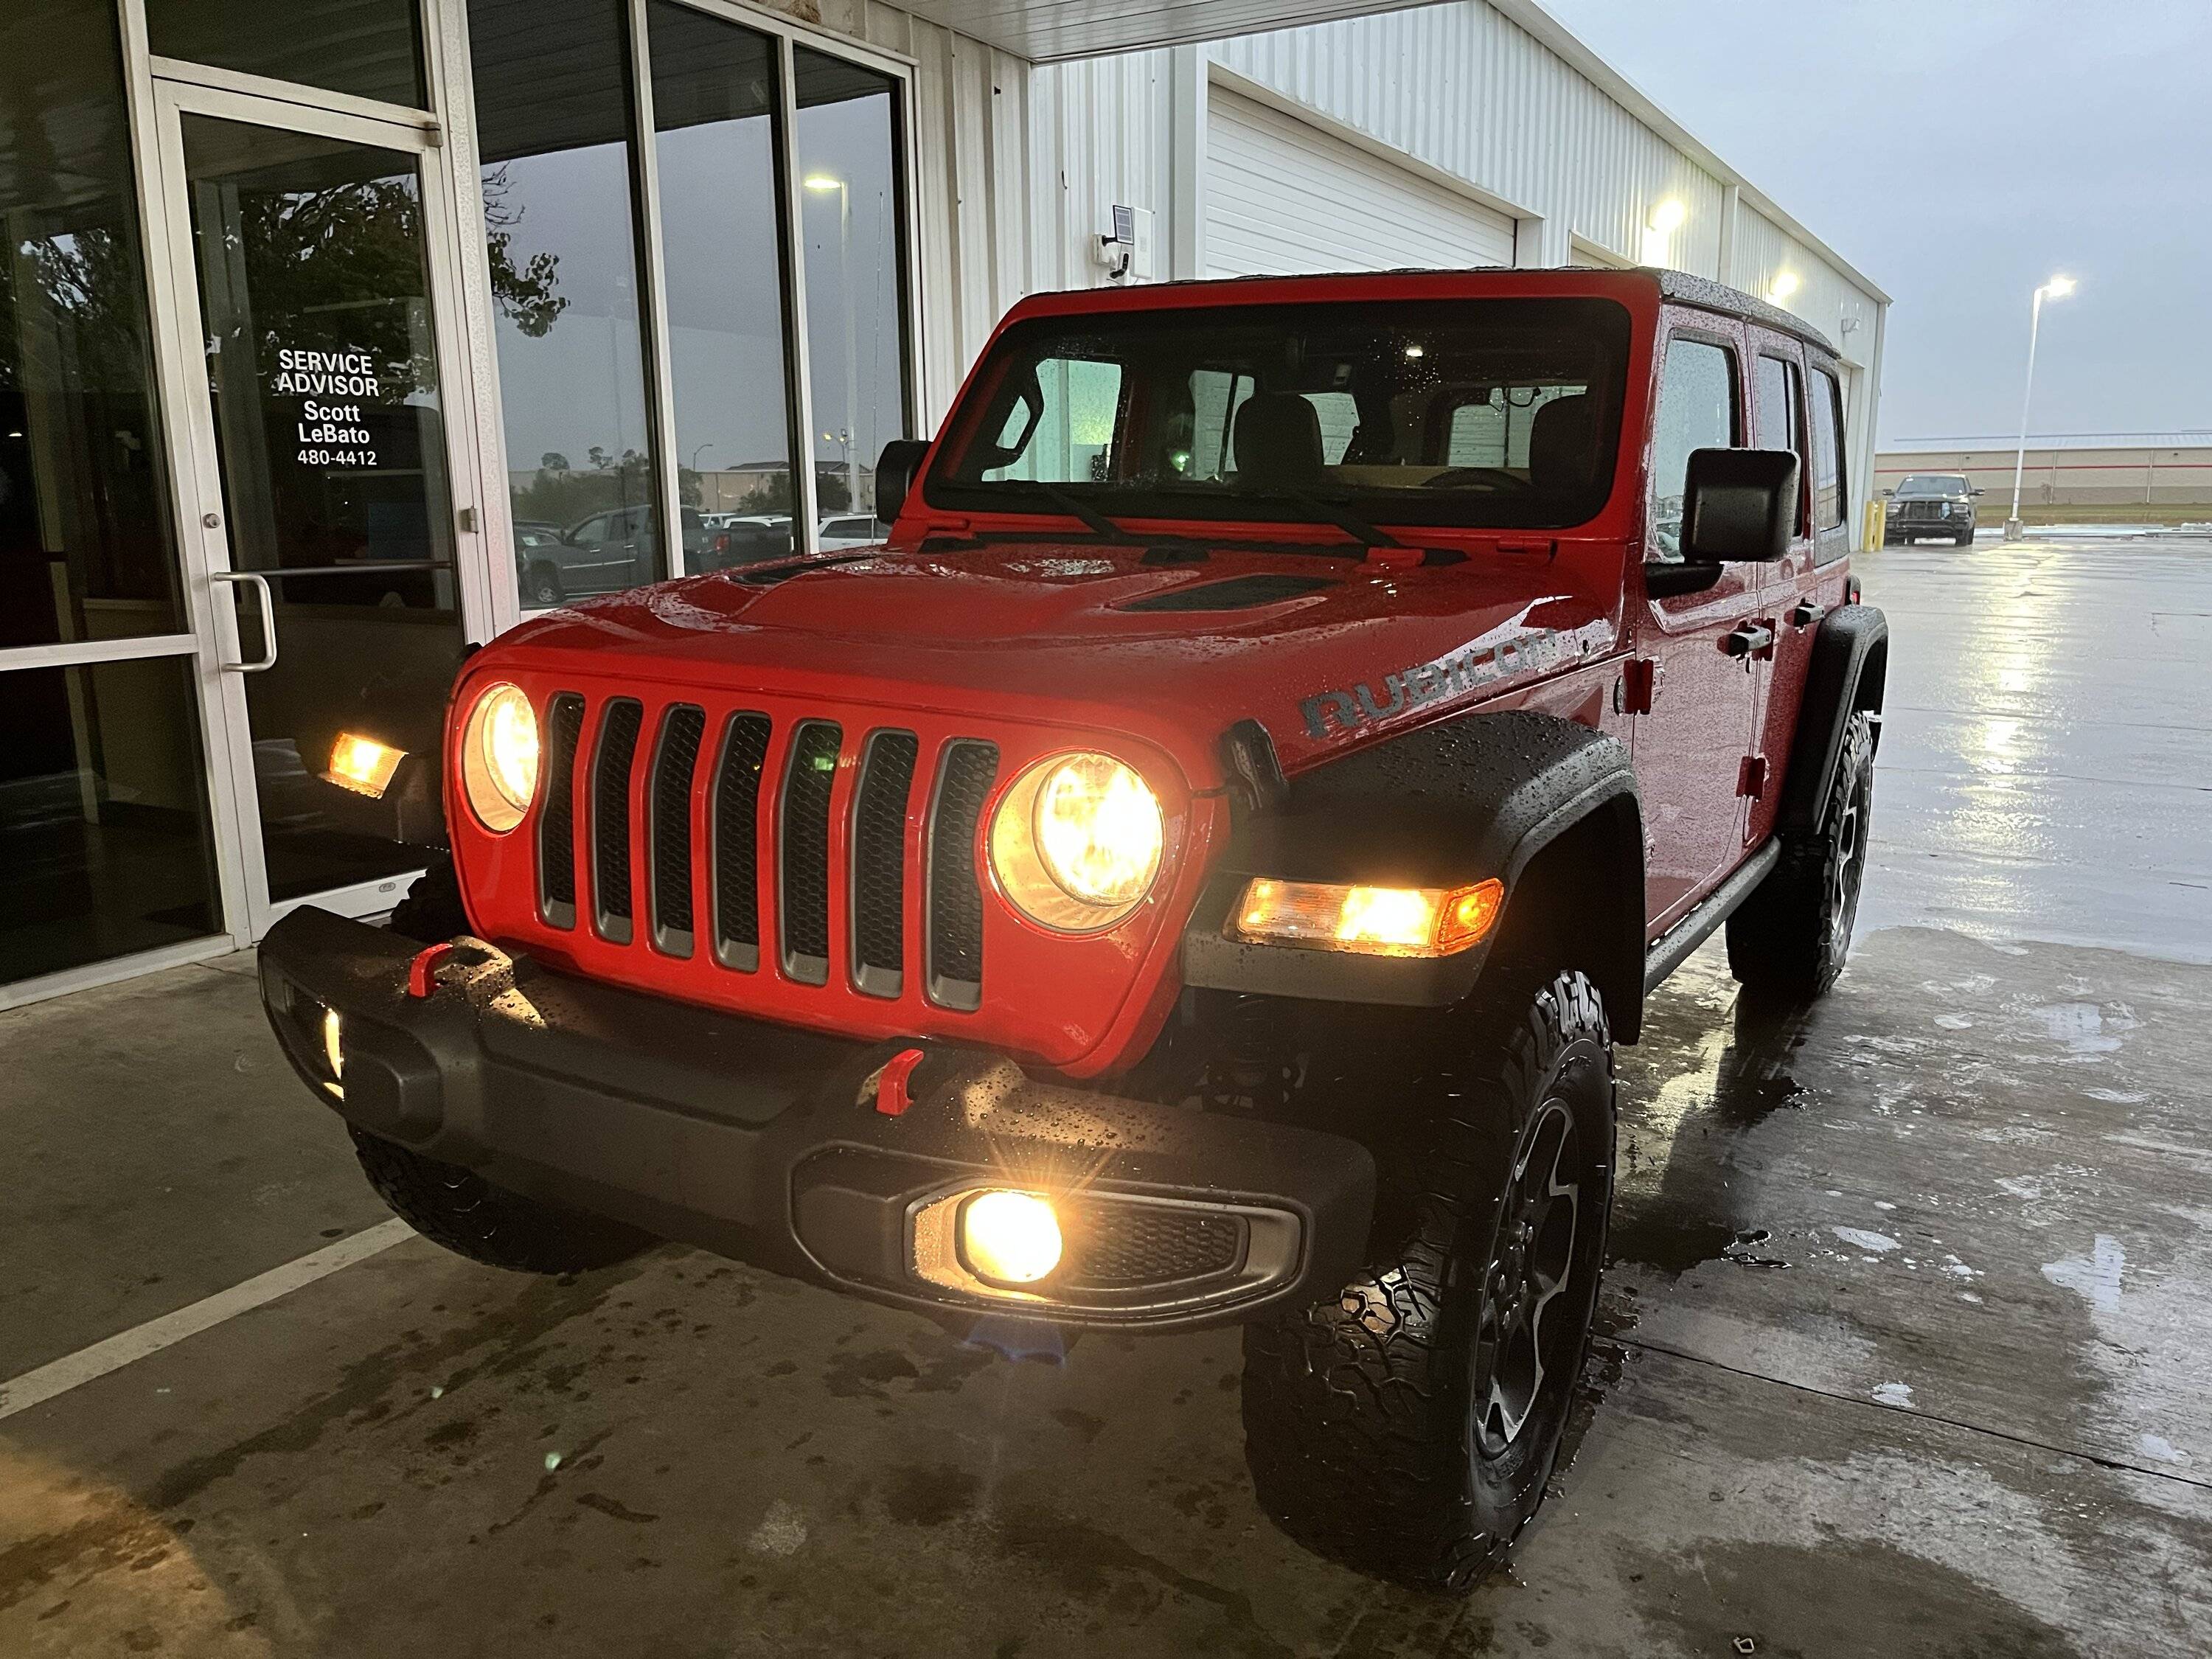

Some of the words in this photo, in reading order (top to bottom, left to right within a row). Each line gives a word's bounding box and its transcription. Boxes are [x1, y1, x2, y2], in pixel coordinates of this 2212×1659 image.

[279, 349, 373, 375] SERVICE
[278, 372, 380, 397] ADVISOR
[304, 400, 361, 422] Scott
[298, 422, 370, 444] LeBato
[297, 450, 378, 465] 480-4412
[1300, 628, 1557, 739] RUBICON
